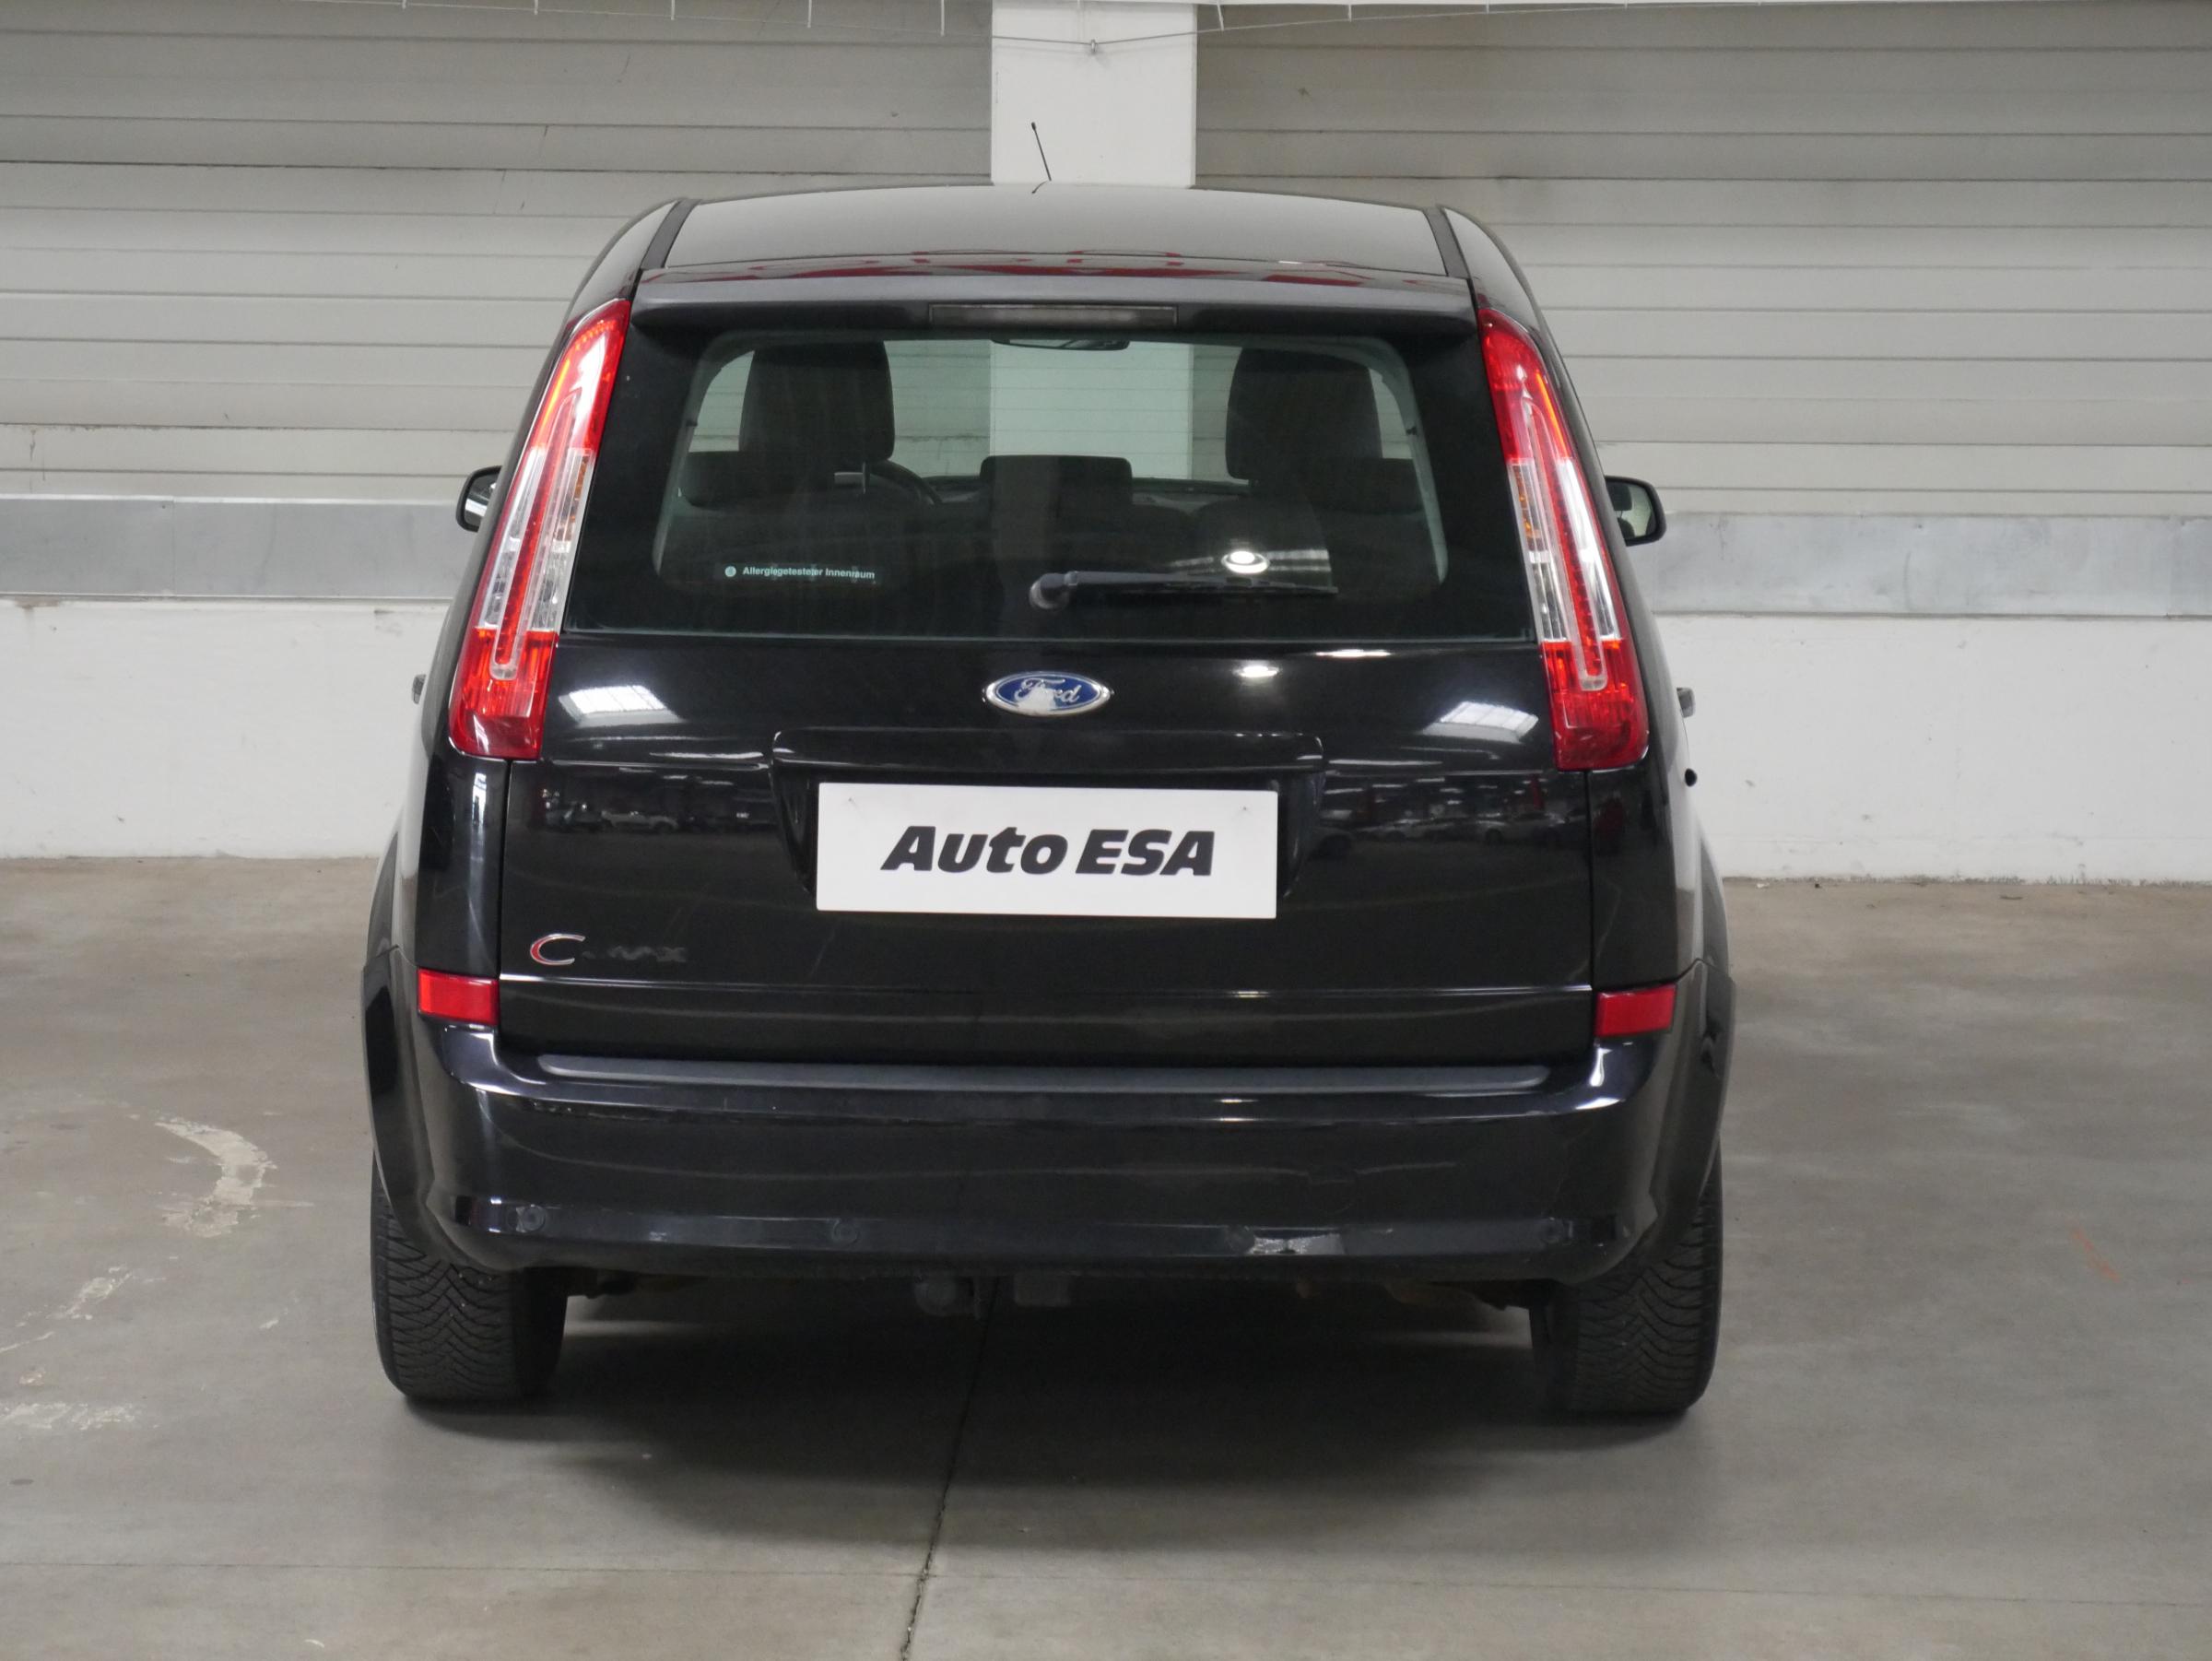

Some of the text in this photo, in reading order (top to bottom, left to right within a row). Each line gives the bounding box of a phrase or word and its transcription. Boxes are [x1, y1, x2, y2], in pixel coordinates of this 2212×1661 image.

[825, 567, 876, 579] Innenraum
[1014, 677, 1082, 705] Fd
[880, 826, 1215, 876] Auto ESA
